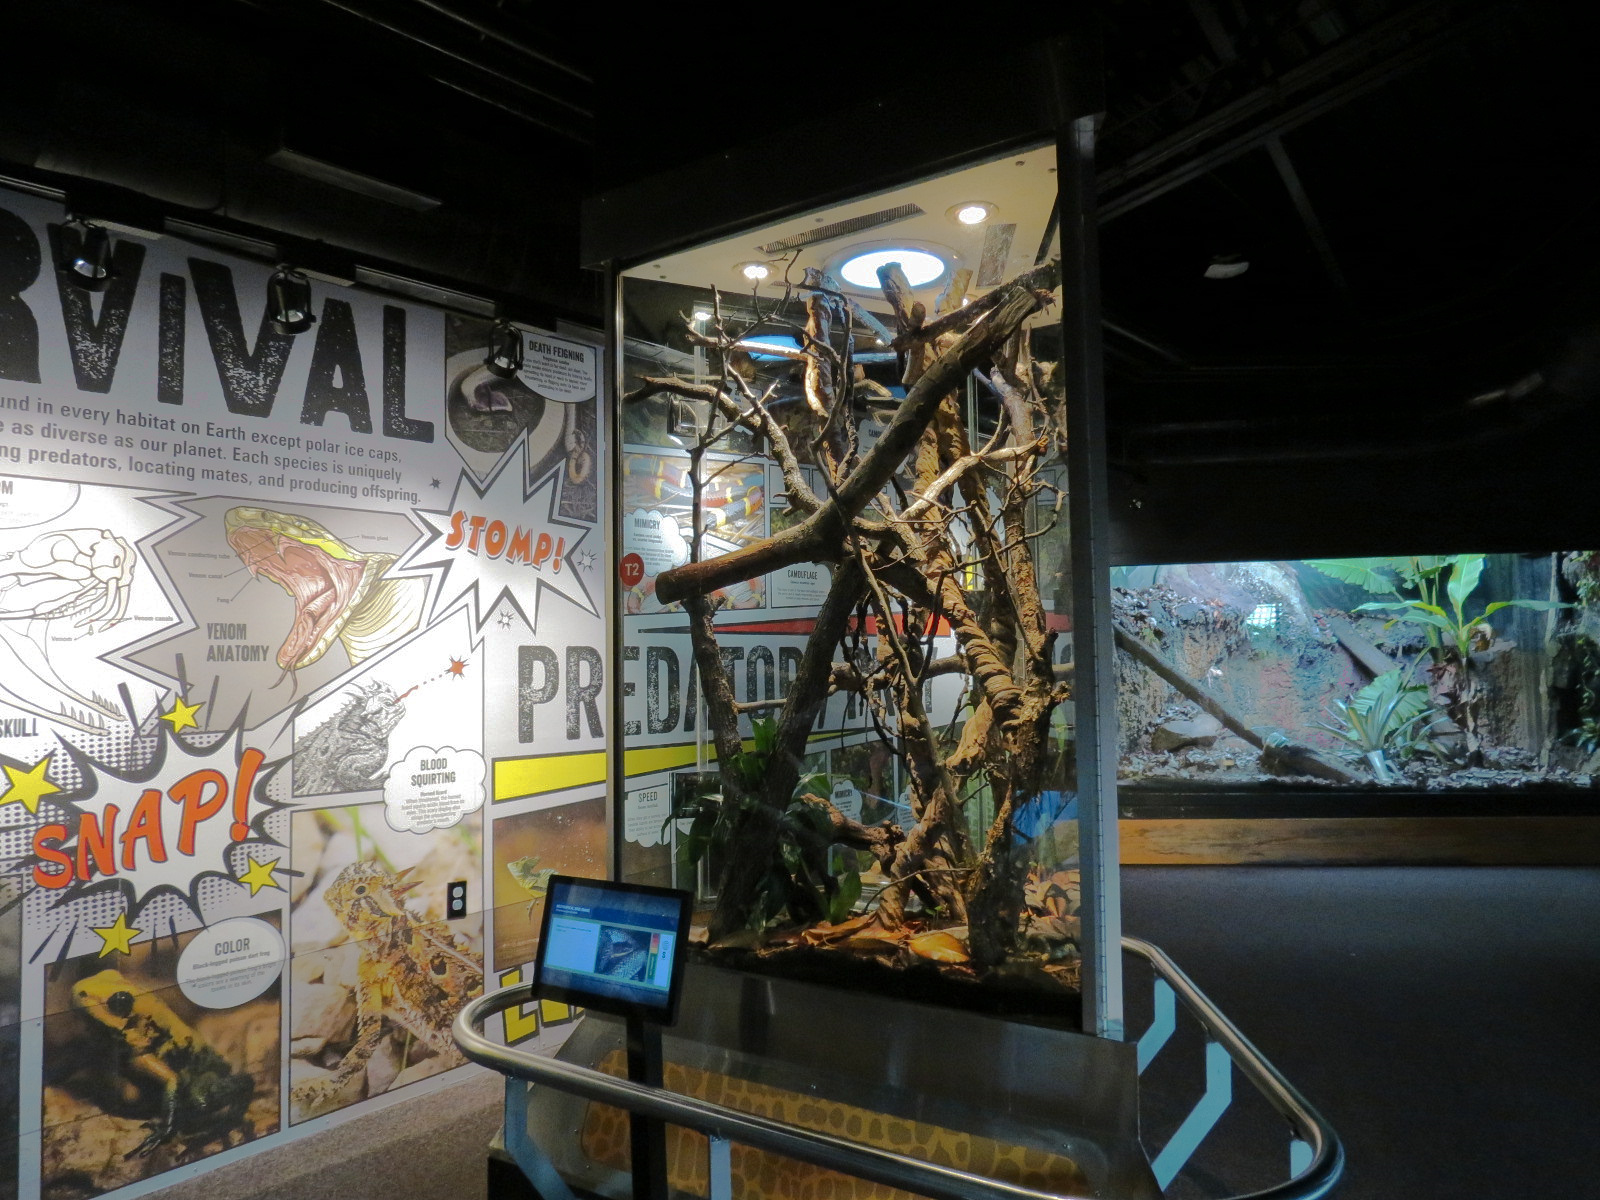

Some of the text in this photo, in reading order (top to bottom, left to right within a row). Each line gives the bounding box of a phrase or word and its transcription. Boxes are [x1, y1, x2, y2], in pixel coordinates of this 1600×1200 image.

[529, 340, 551, 354] DEATH
[553, 346, 584, 363] FEIGNING
[37, 398, 53, 414] in
[60, 405, 110, 425] every
[117, 409, 176, 431] habitat
[181, 422, 200, 435] on
[206, 422, 246, 441] Earth
[251, 432, 301, 449] except
[306, 438, 340, 454] polar
[345, 442, 364, 457] ice
[369, 449, 401, 463] caps,
[11, 422, 34, 436] as
[41, 423, 108, 445] diverse
[114, 435, 134, 448] as
[140, 439, 168, 452] our
[173, 441, 227, 460] planet.
[233, 447, 268, 465] Each
[274, 455, 328, 472] species
[333, 460, 344, 474] is
[349, 465, 402, 484] uniquely
[28, 448, 123, 471] predators,
[128, 456, 195, 481] locating
[201, 466, 252, 486] mates,
[258, 473, 284, 488] and
[290, 477, 357, 498] producing
[362, 484, 421, 505] offspring.
[445, 509, 566, 574] STOMP!
[625, 563, 639, 576] T2
[788, 569, 818, 580] CAMOUFLAGE
[207, 623, 247, 640] VENOM
[207, 645, 269, 662] ANATOMY
[420, 758, 448, 771] BLOOD
[411, 771, 456, 788] SQUIRTING
[639, 791, 658, 802] SPEED
[32, 747, 266, 889] SNAP!
[215, 938, 250, 956] COLOR
